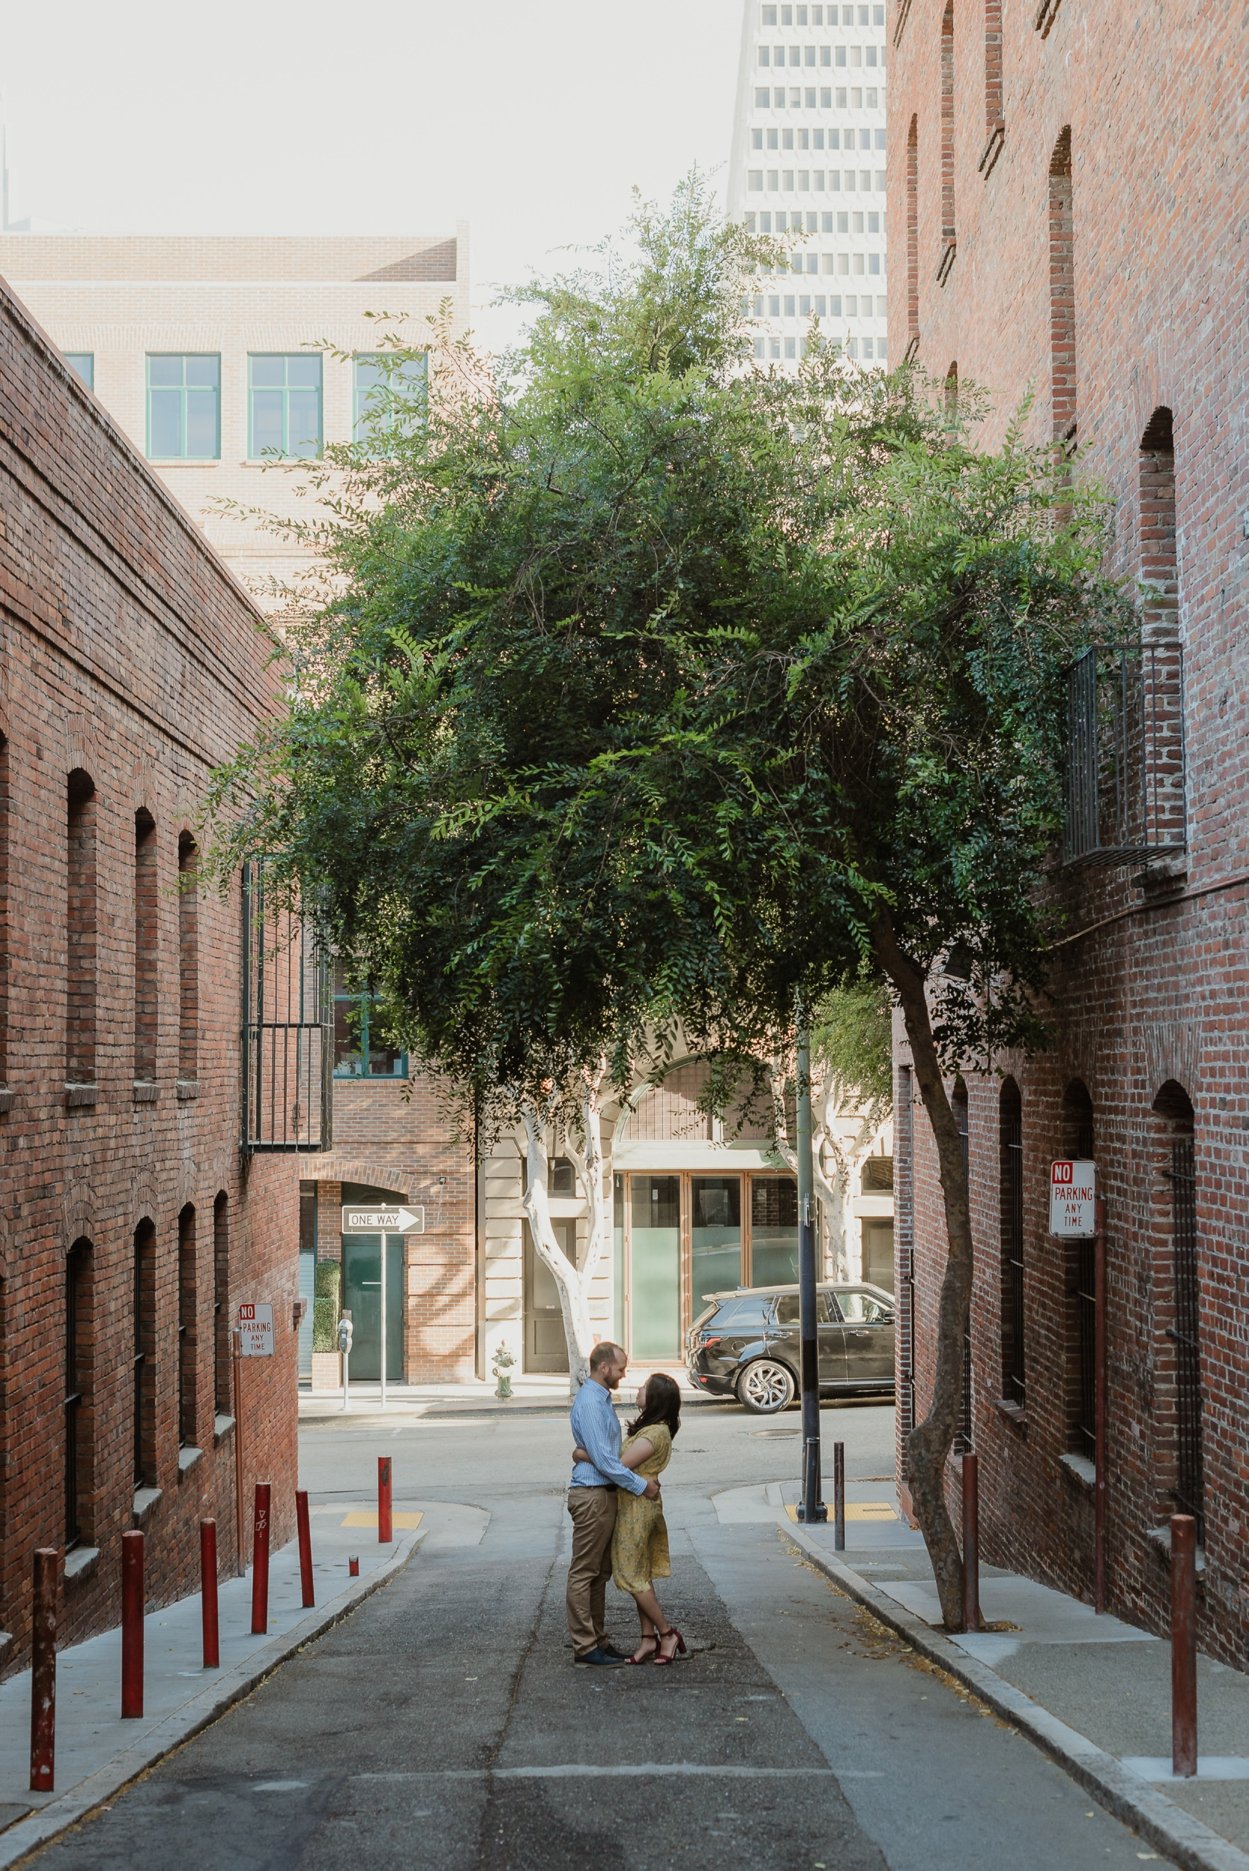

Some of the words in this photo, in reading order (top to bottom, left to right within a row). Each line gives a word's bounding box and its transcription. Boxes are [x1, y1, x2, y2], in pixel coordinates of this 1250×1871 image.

[1054, 1164, 1071, 1181] NO
[1055, 1187, 1093, 1200] PARKING
[1064, 1203, 1082, 1214] ANY
[351, 1214, 373, 1225] ONE
[377, 1215, 399, 1225] WAY
[1064, 1216, 1083, 1227] TIME
[241, 1305, 254, 1319] NO
[242, 1322, 272, 1332] PARKING
